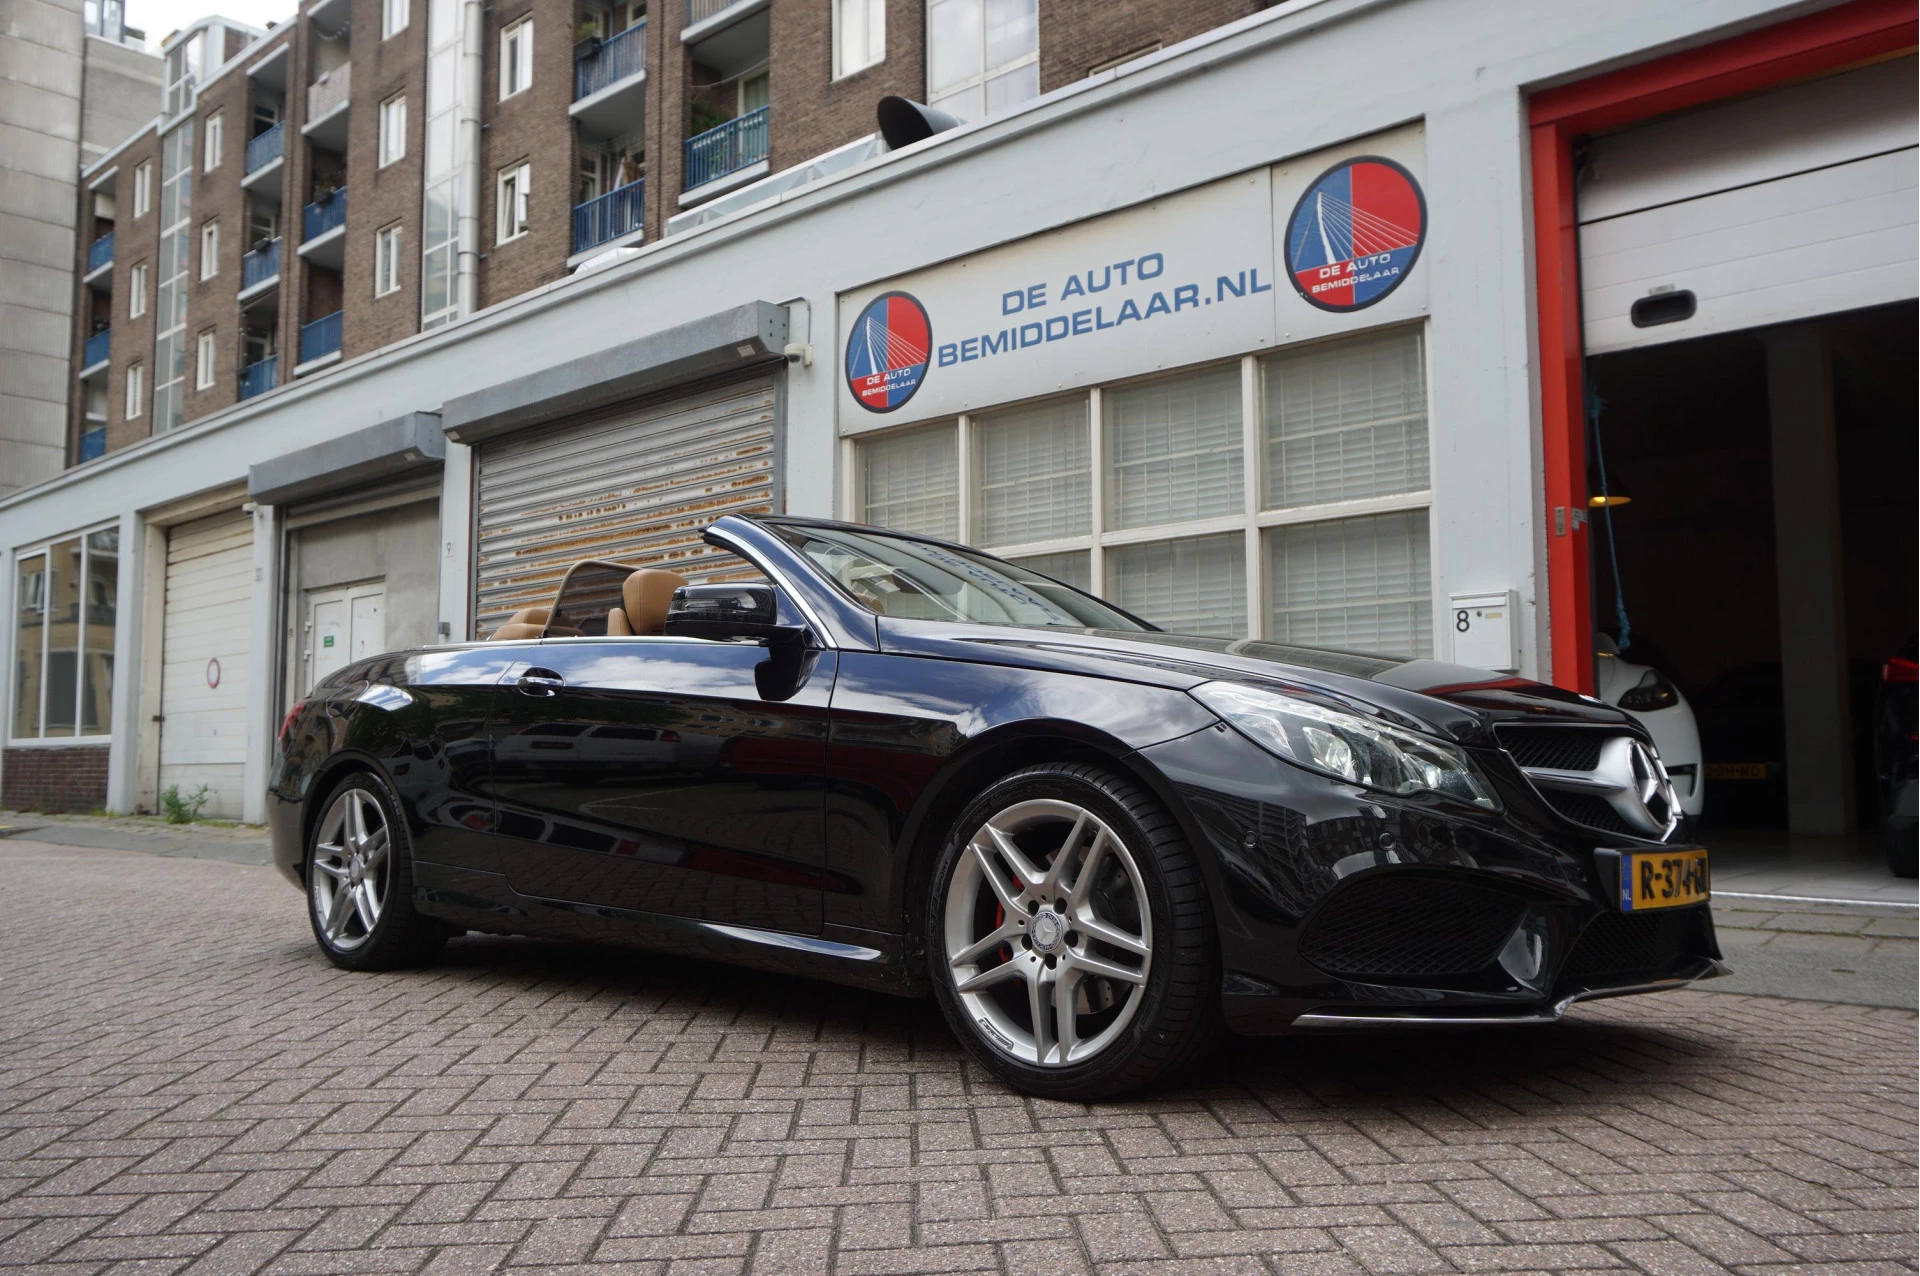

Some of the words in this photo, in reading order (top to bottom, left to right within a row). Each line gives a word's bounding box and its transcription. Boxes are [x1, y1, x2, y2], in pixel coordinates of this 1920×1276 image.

[1319, 264, 1341, 279] DE
[1346, 252, 1391, 272] AUTO
[1002, 284, 1047, 315] DE
[1061, 253, 1164, 300] AUTO
[1312, 266, 1400, 293] BEMIDDELAAR
[937, 268, 1272, 367] BEMIDDELAAR.NL
[862, 379, 916, 396] BEMIDDELAAR
[866, 376, 880, 385] DE
[884, 368, 910, 381] AUTO
[1456, 609, 1471, 633] 8
[1622, 888, 1632, 901] NL
